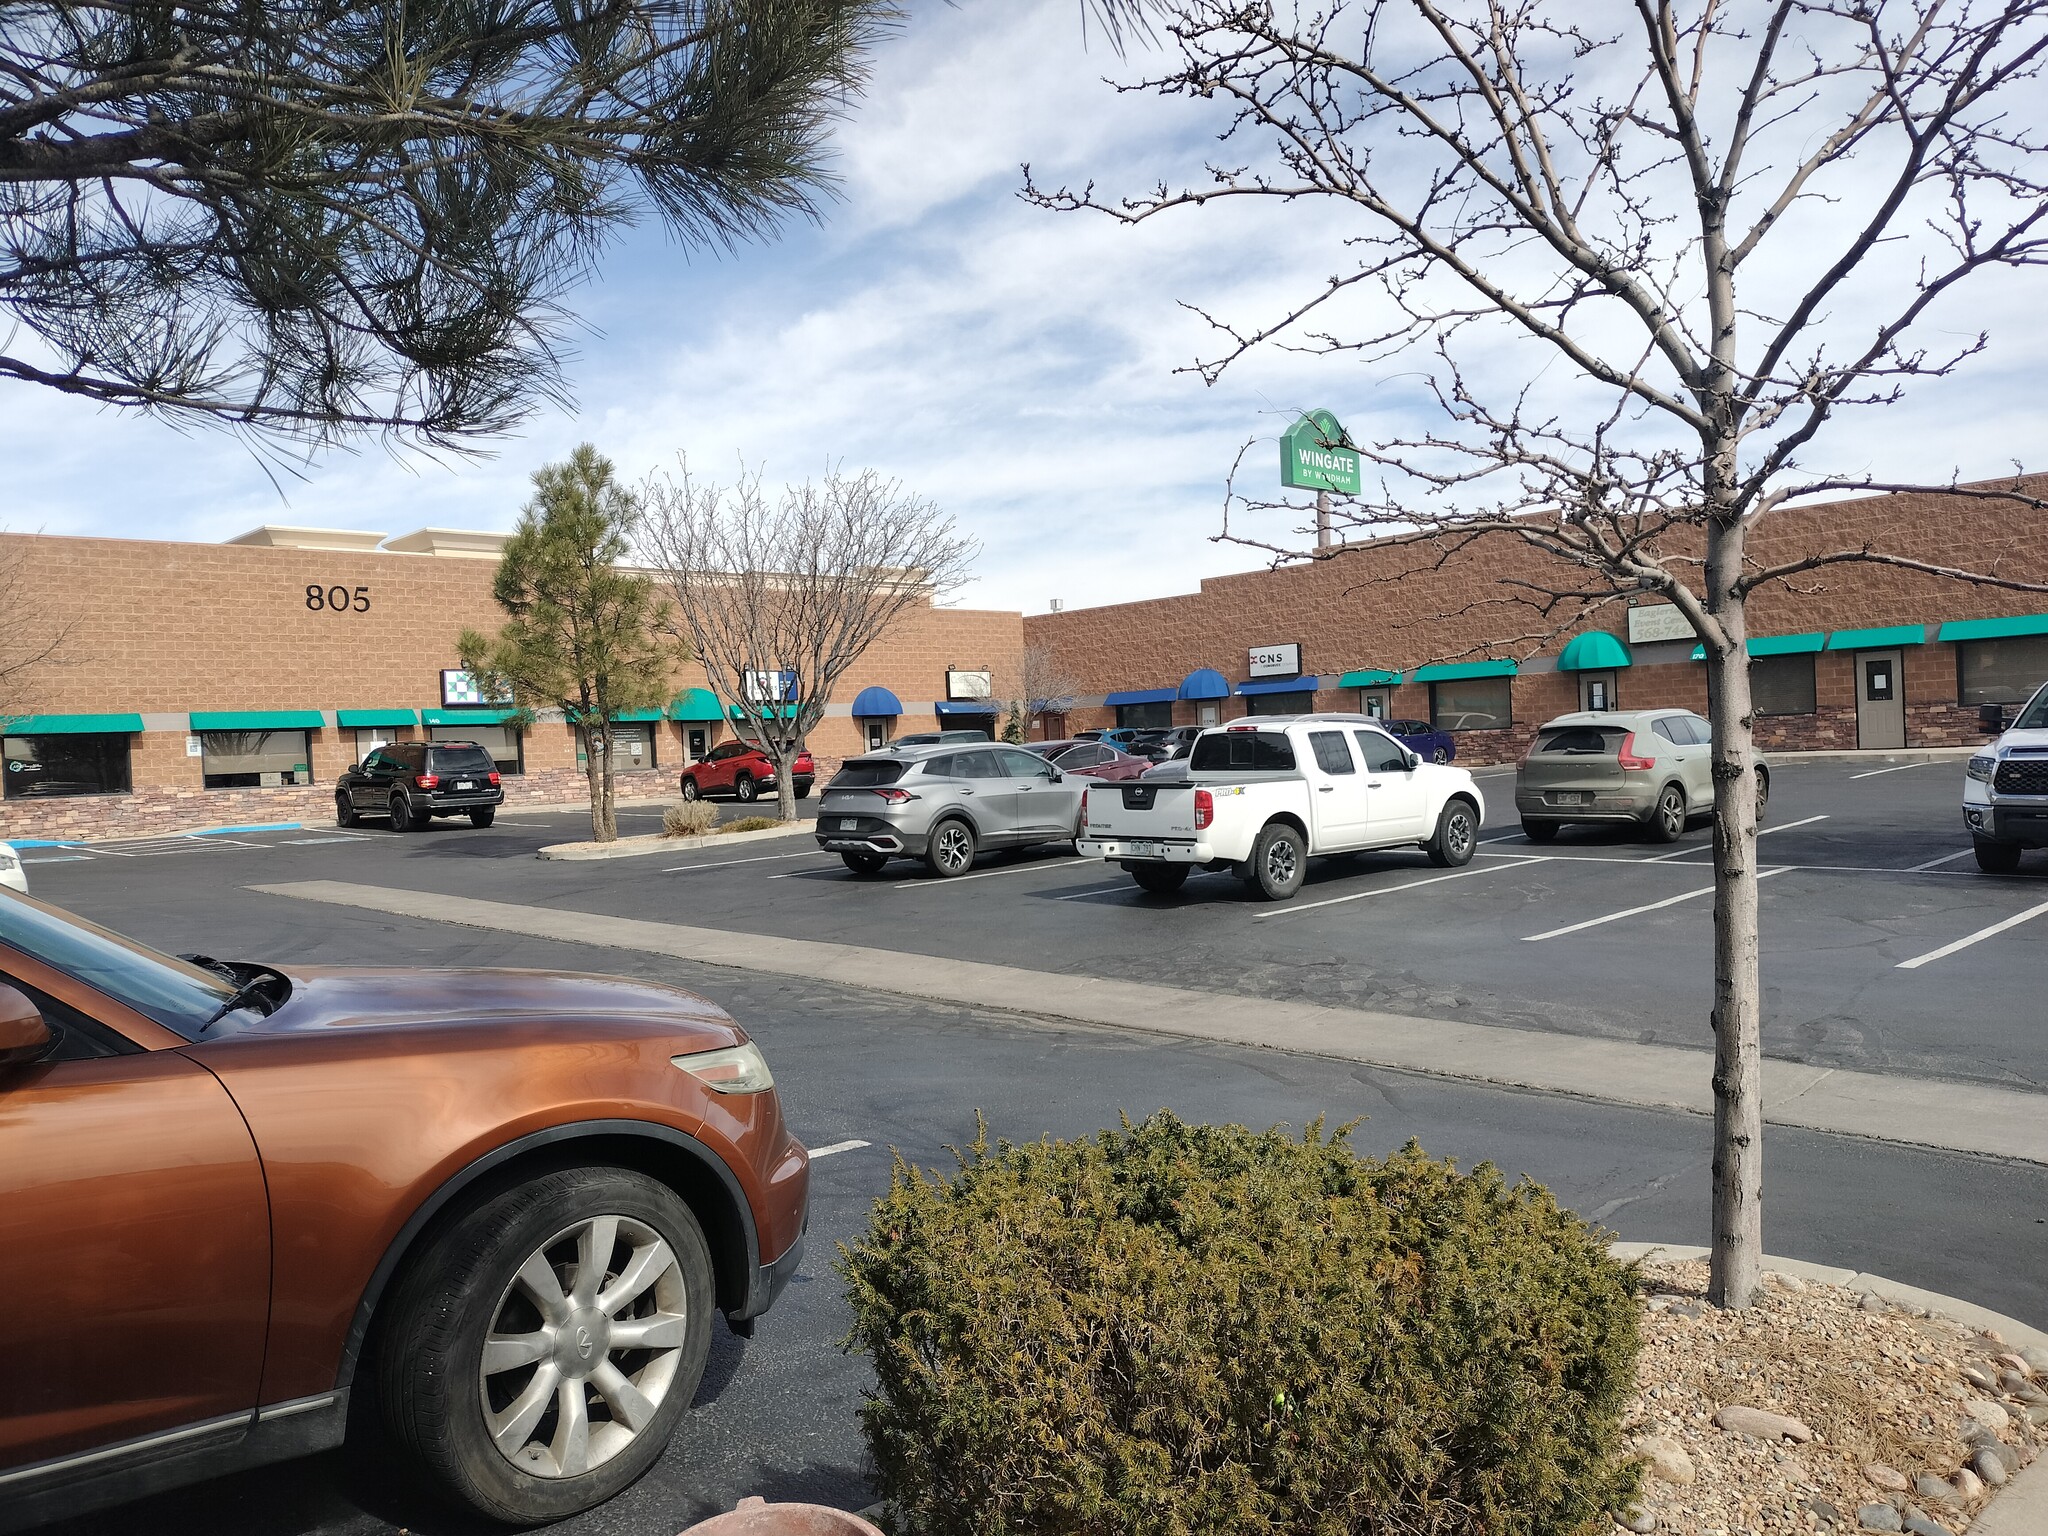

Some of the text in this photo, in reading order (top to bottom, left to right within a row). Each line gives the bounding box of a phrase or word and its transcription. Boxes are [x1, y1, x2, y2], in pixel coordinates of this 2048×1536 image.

[1299, 449, 1353, 473] WINGATE
[1303, 469, 1312, 477] BY
[306, 584, 371, 612] 805
[1259, 653, 1283, 664] CNS
